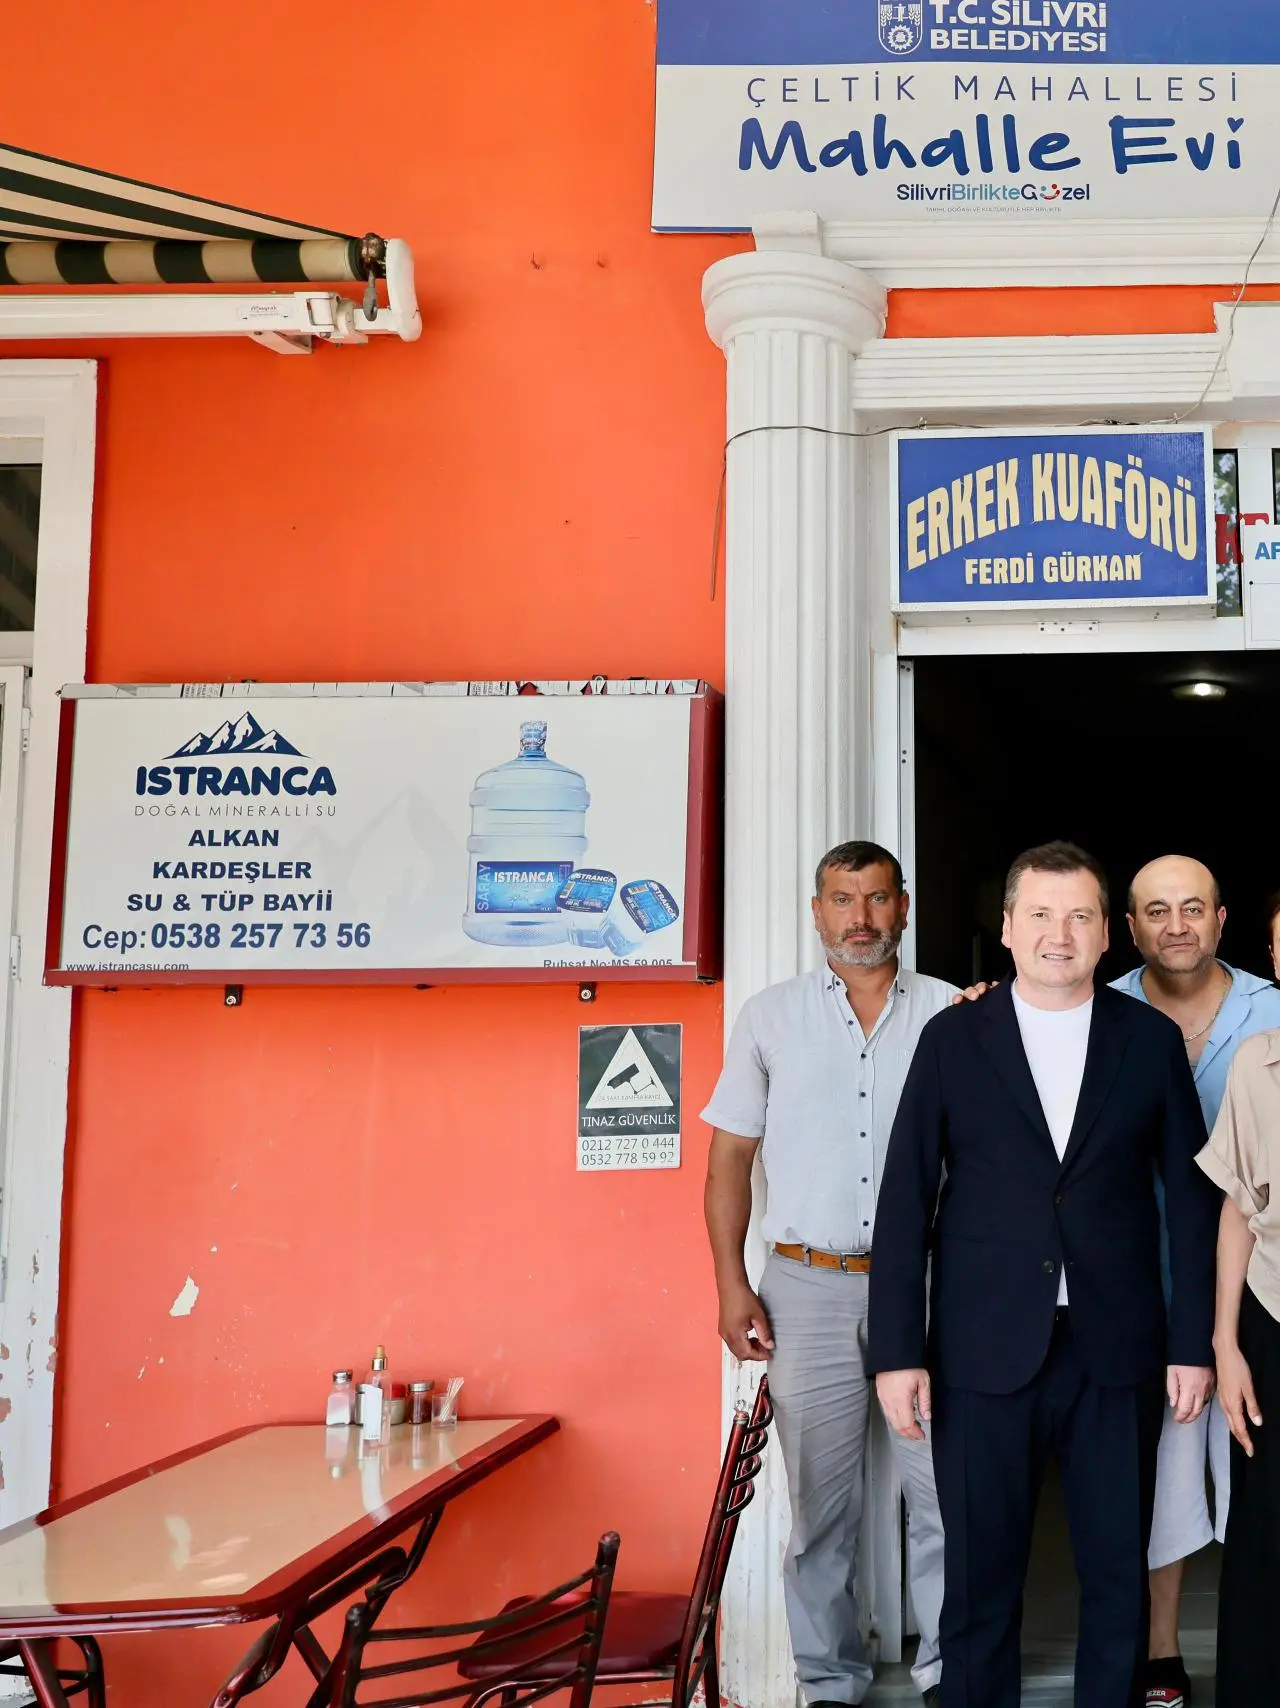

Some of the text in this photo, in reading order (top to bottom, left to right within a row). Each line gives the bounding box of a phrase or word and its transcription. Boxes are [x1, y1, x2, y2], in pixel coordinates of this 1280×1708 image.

[929, 0, 1107, 28] T.C. SİLİVRİ
[930, 29, 1107, 52] BELEDİYESİ
[746, 70, 1238, 107] ÇELTİK MAHALLESİ
[738, 112, 1245, 176] Mahalle Evi
[906, 457, 1020, 571] ERKEK
[1032, 452, 1197, 561] KUAFÖRÜ
[965, 551, 1142, 585] FERDİ GÜRKAN
[136, 766, 337, 796] ISTRANCA
[134, 803, 336, 817] DOĞAL MİNERALLİ SU
[188, 829, 279, 847] ALKAN
[153, 861, 312, 883] KARDEŞLER
[494, 871, 554, 883] ISTRANCA
[127, 889, 333, 912] SU & TÜP BAYİİ
[151, 923, 220, 949] 0538
[230, 923, 283, 948] 257
[293, 923, 327, 948] 73
[336, 922, 371, 948] 56
[66, 961, 190, 971] www.istrancasu.com
[582, 1112, 676, 1127] TINAZ GÜVENLİK
[582, 1137, 675, 1151] 0212 727 0 444
[582, 1151, 675, 1166] 0532 778 59 92
